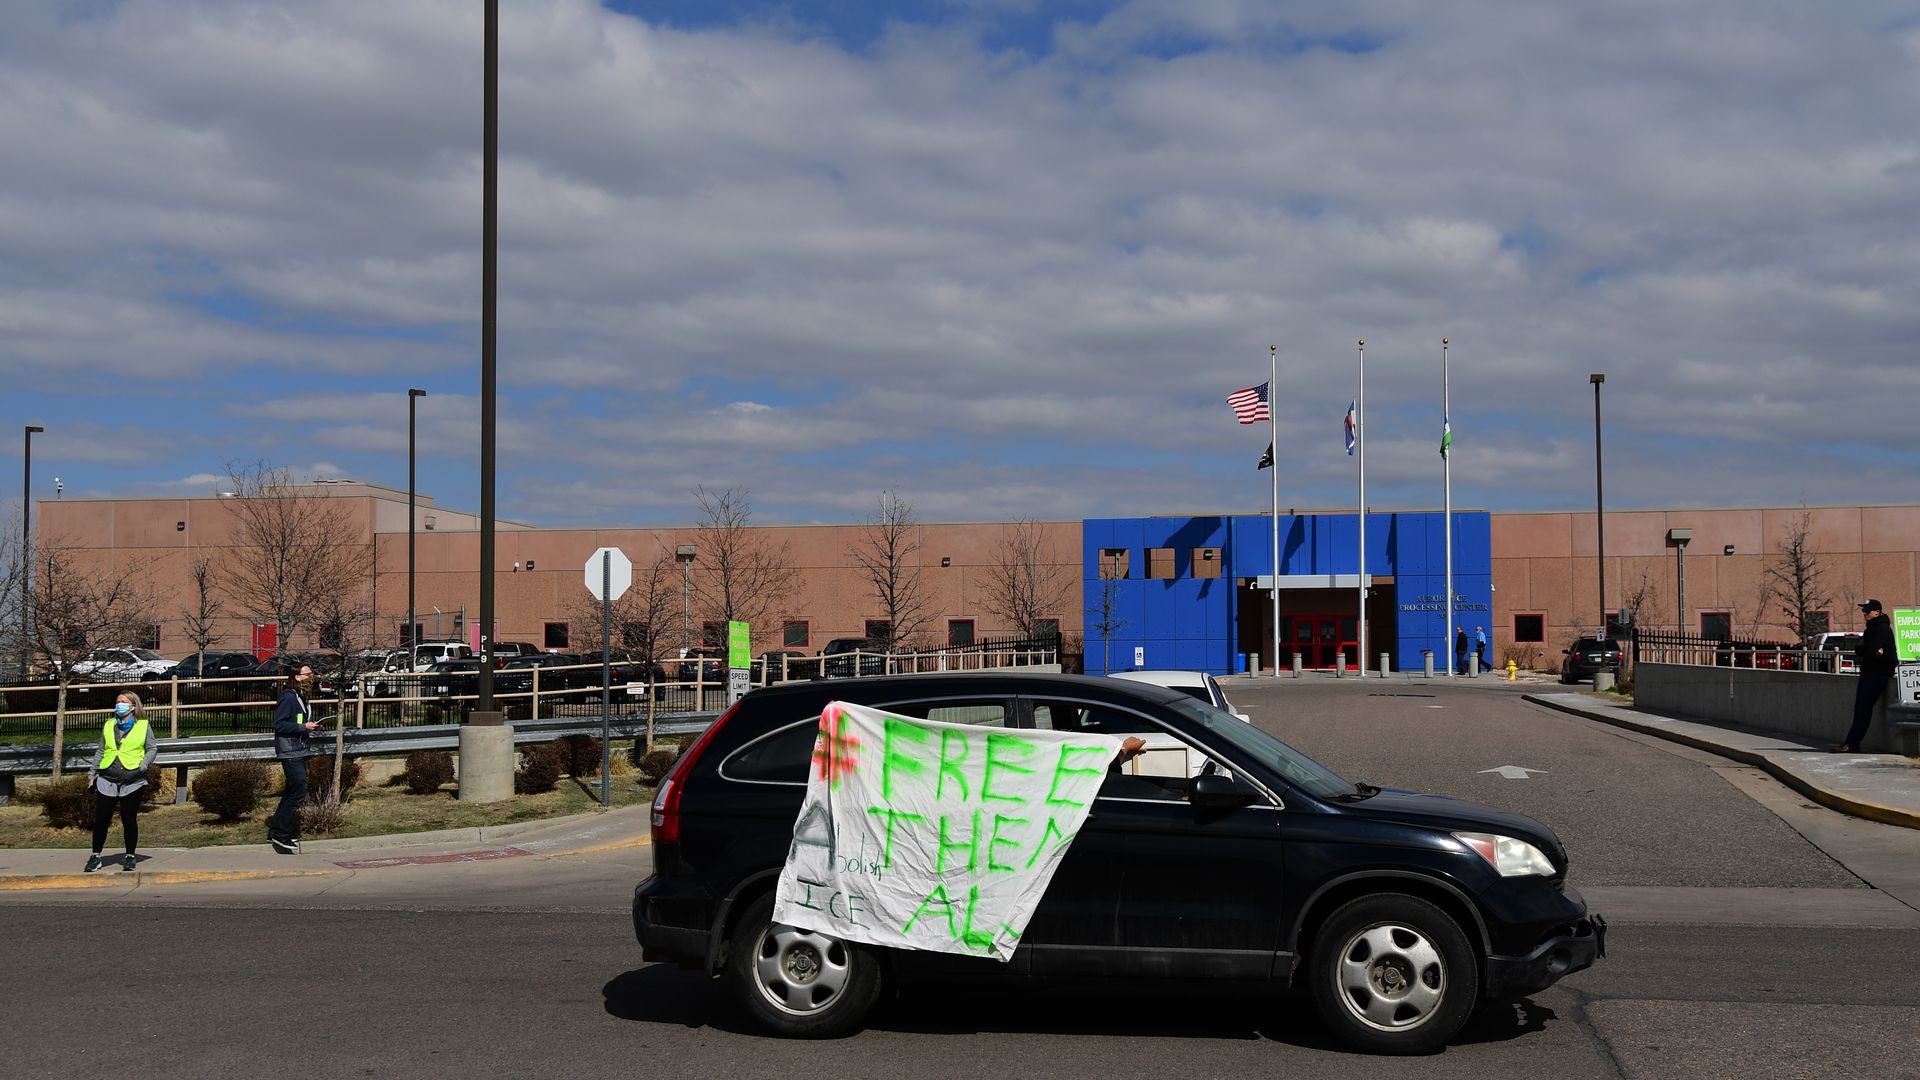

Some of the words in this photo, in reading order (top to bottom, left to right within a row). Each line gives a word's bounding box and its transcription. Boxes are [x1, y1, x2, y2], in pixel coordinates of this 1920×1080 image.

[1416, 595, 1450, 603] AUROR
[1455, 604, 1488, 612] CENTER
[731, 672, 749, 681] SPEED
[732, 682, 747, 690] LIMIT
[795, 879, 870, 930] ICE
